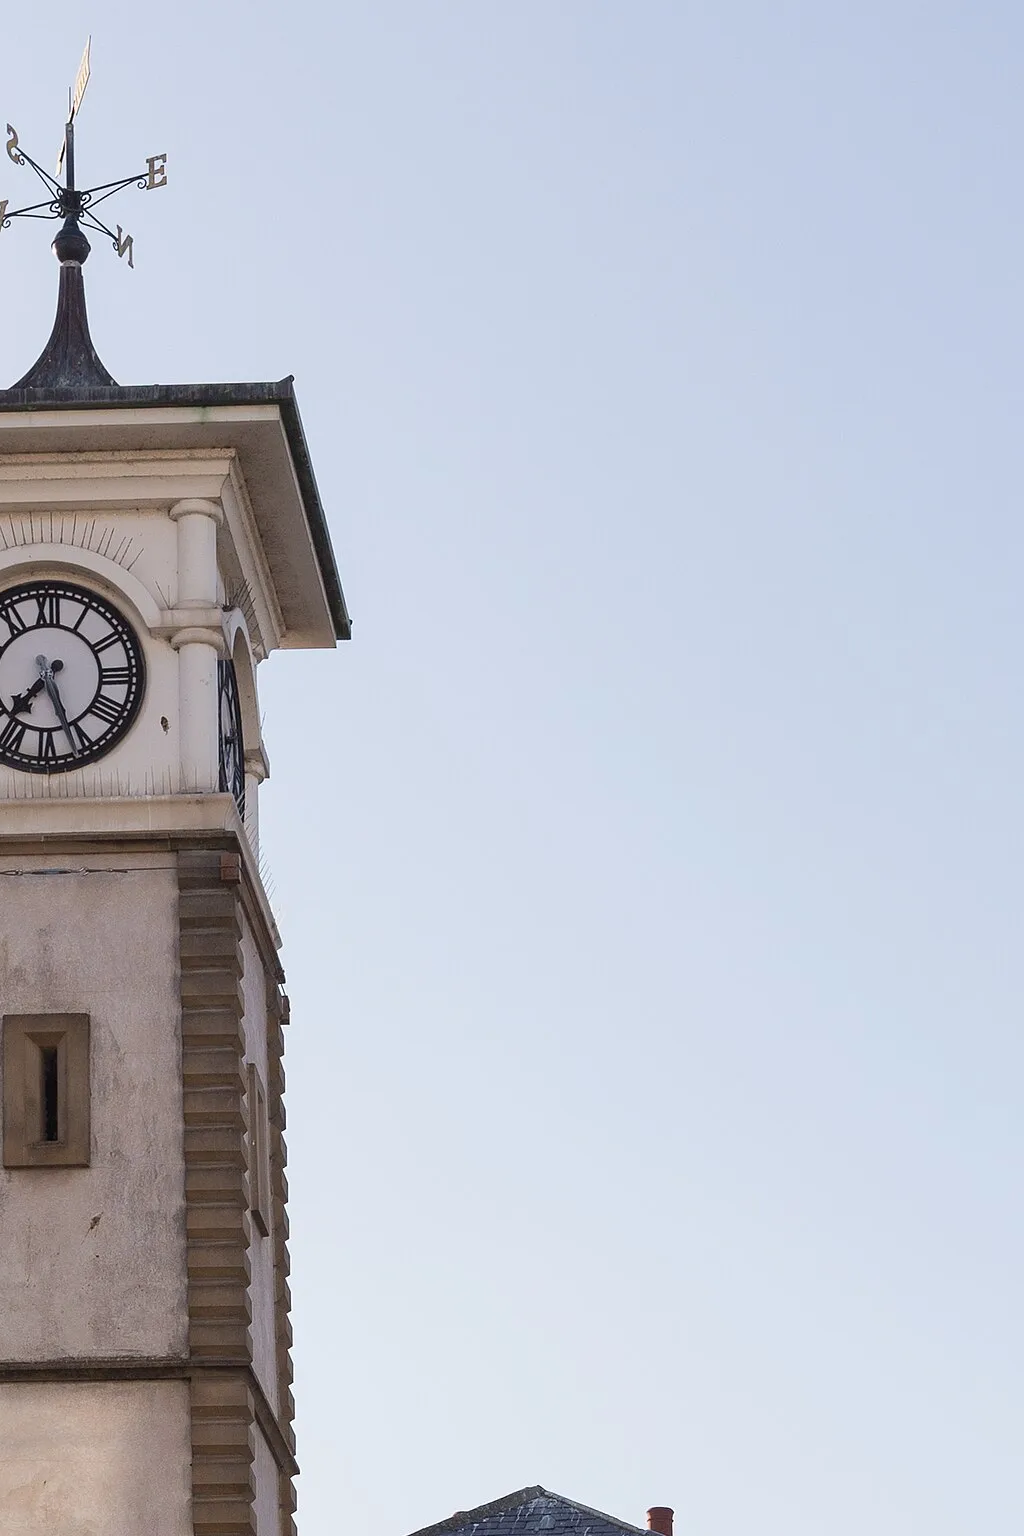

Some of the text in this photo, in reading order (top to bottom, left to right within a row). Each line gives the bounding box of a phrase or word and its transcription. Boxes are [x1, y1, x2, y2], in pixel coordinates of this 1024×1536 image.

[145, 153, 167, 190] E
[35, 597, 60, 625] XII
[92, 630, 122, 654] II
[102, 667, 129, 685] III
